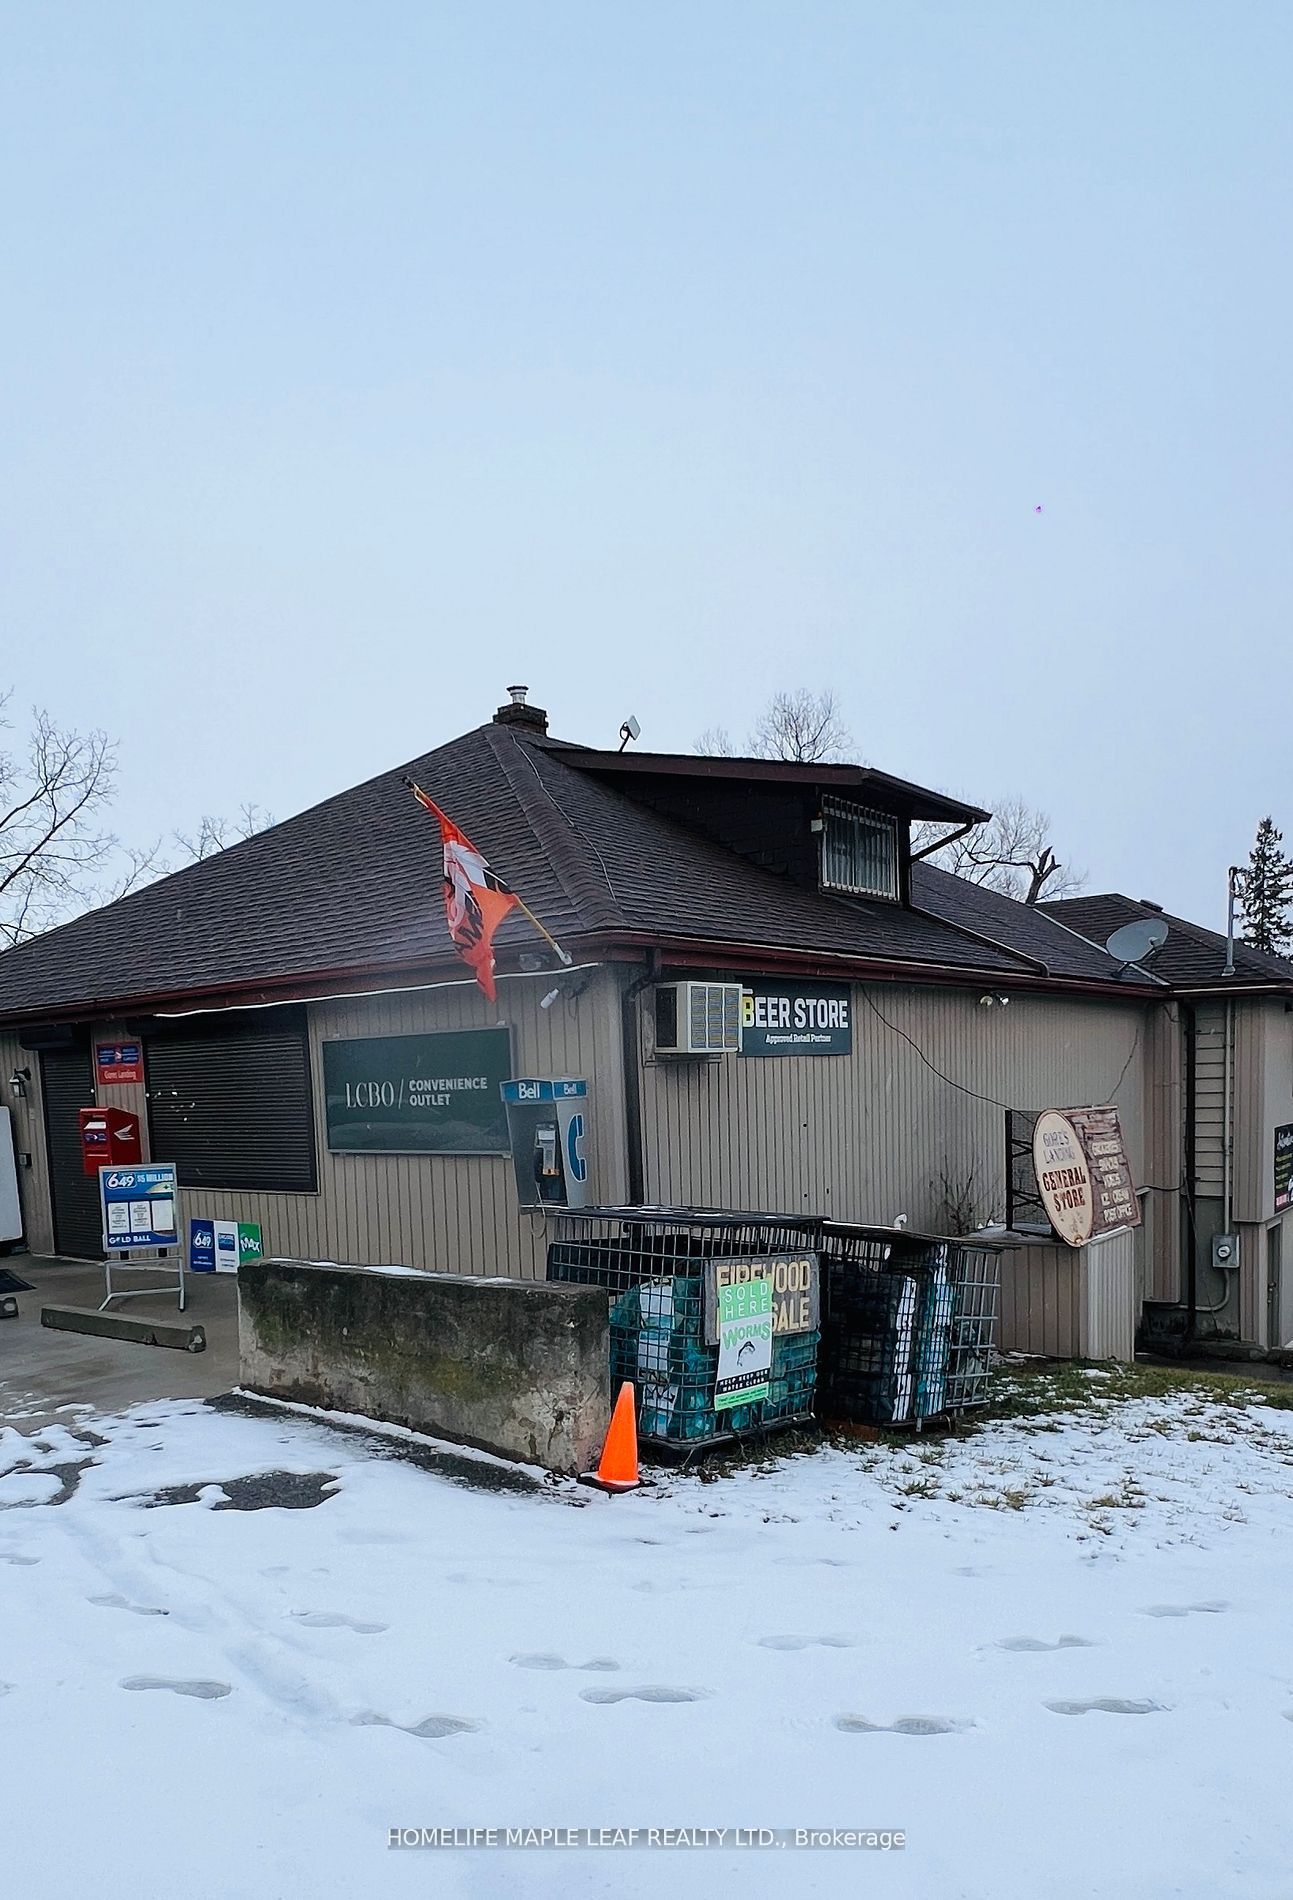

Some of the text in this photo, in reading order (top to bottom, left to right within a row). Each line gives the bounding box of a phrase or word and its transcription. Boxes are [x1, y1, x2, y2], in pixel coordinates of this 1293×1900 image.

[742, 996, 849, 1029] BEER STORE
[345, 1077, 489, 1110] LCBO CONVENIENCE
[518, 1082, 541, 1100] Bell
[563, 1080, 577, 1096] Bell
[409, 1093, 452, 1107] OUTLET
[107, 1173, 135, 1188] 649
[1042, 1167, 1086, 1191] GENERAL
[1053, 1186, 1086, 1213] STORE
[194, 1232, 212, 1248] 649
[724, 1282, 768, 1303] SOLD
[725, 1297, 769, 1320] HERE
[722, 1321, 771, 1350] WORMS
